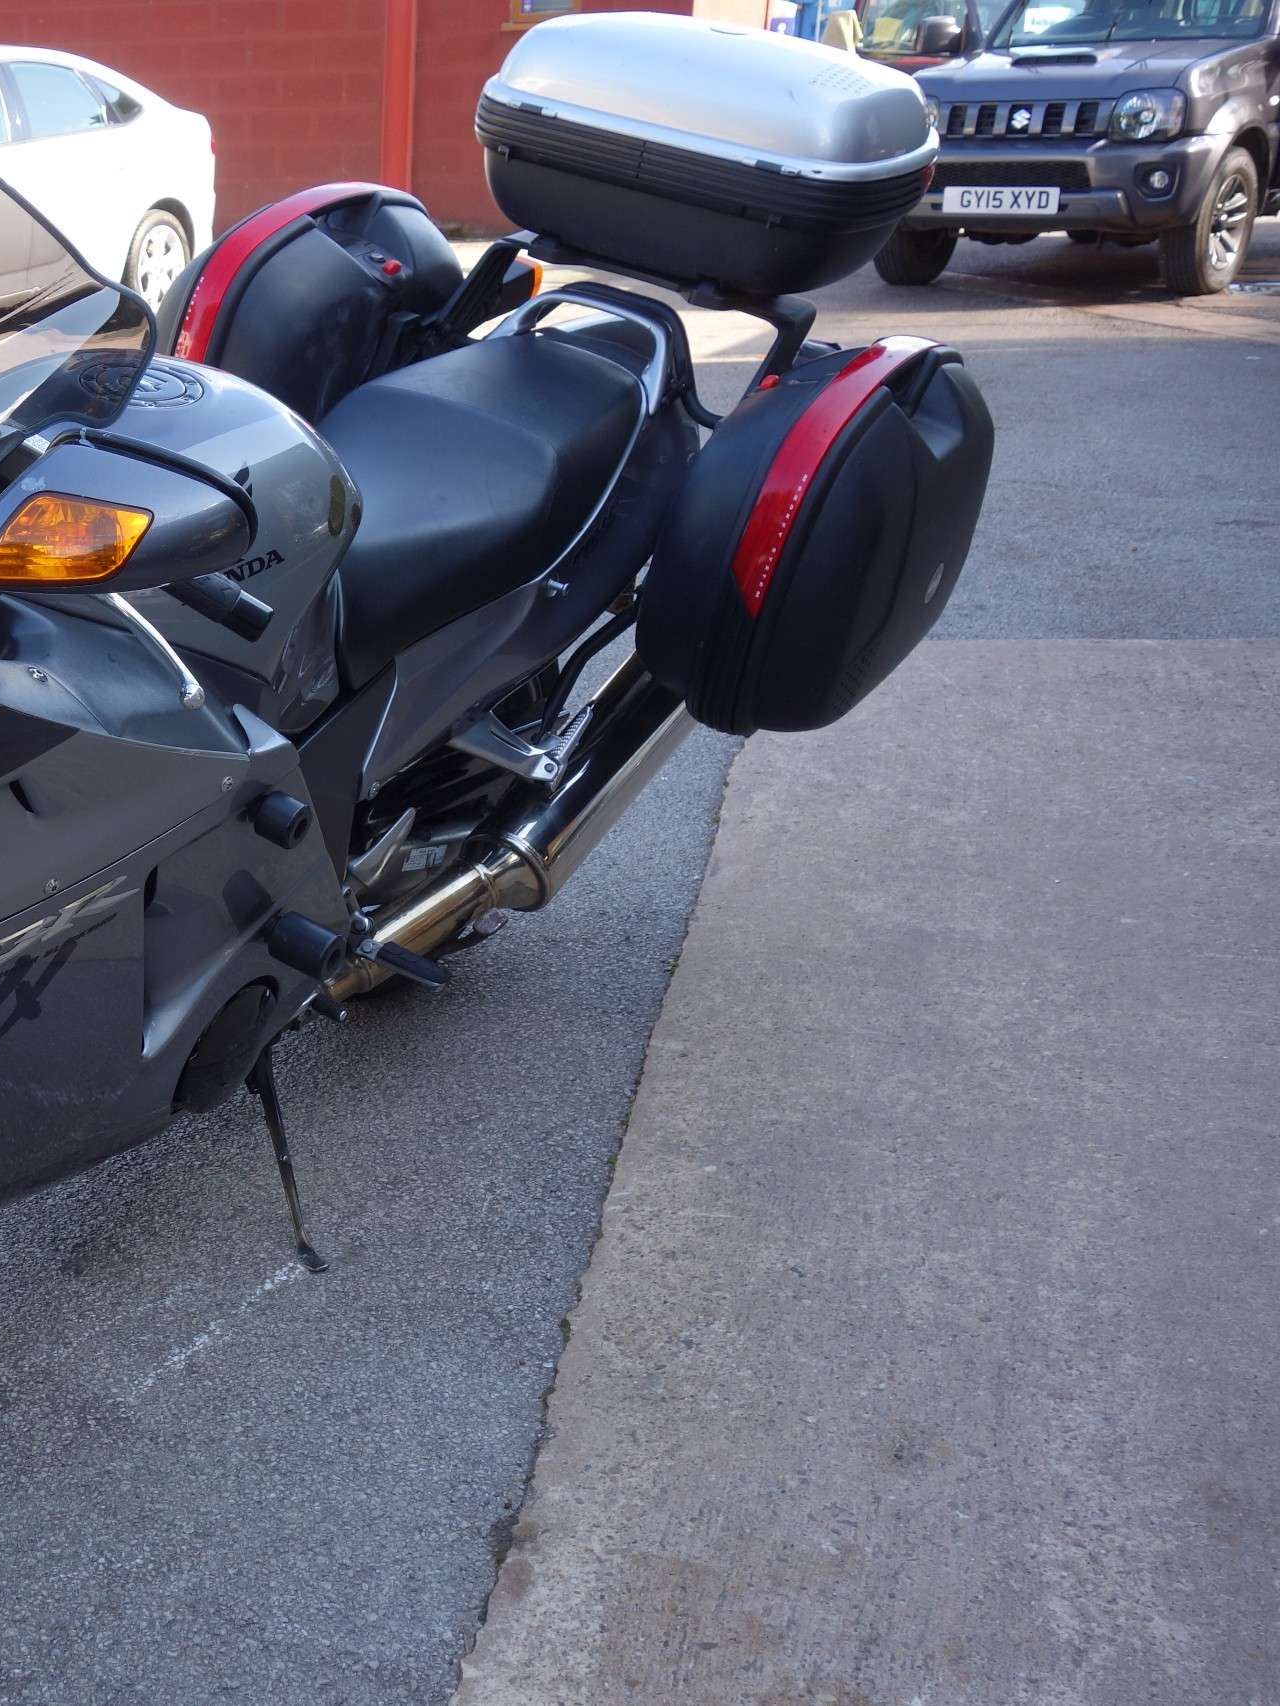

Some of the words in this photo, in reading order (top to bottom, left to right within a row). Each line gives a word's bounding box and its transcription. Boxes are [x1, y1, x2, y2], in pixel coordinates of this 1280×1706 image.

[960, 190, 1004, 209] GY15
[1010, 190, 1050, 209] XYD
[223, 549, 286, 582] NDA
